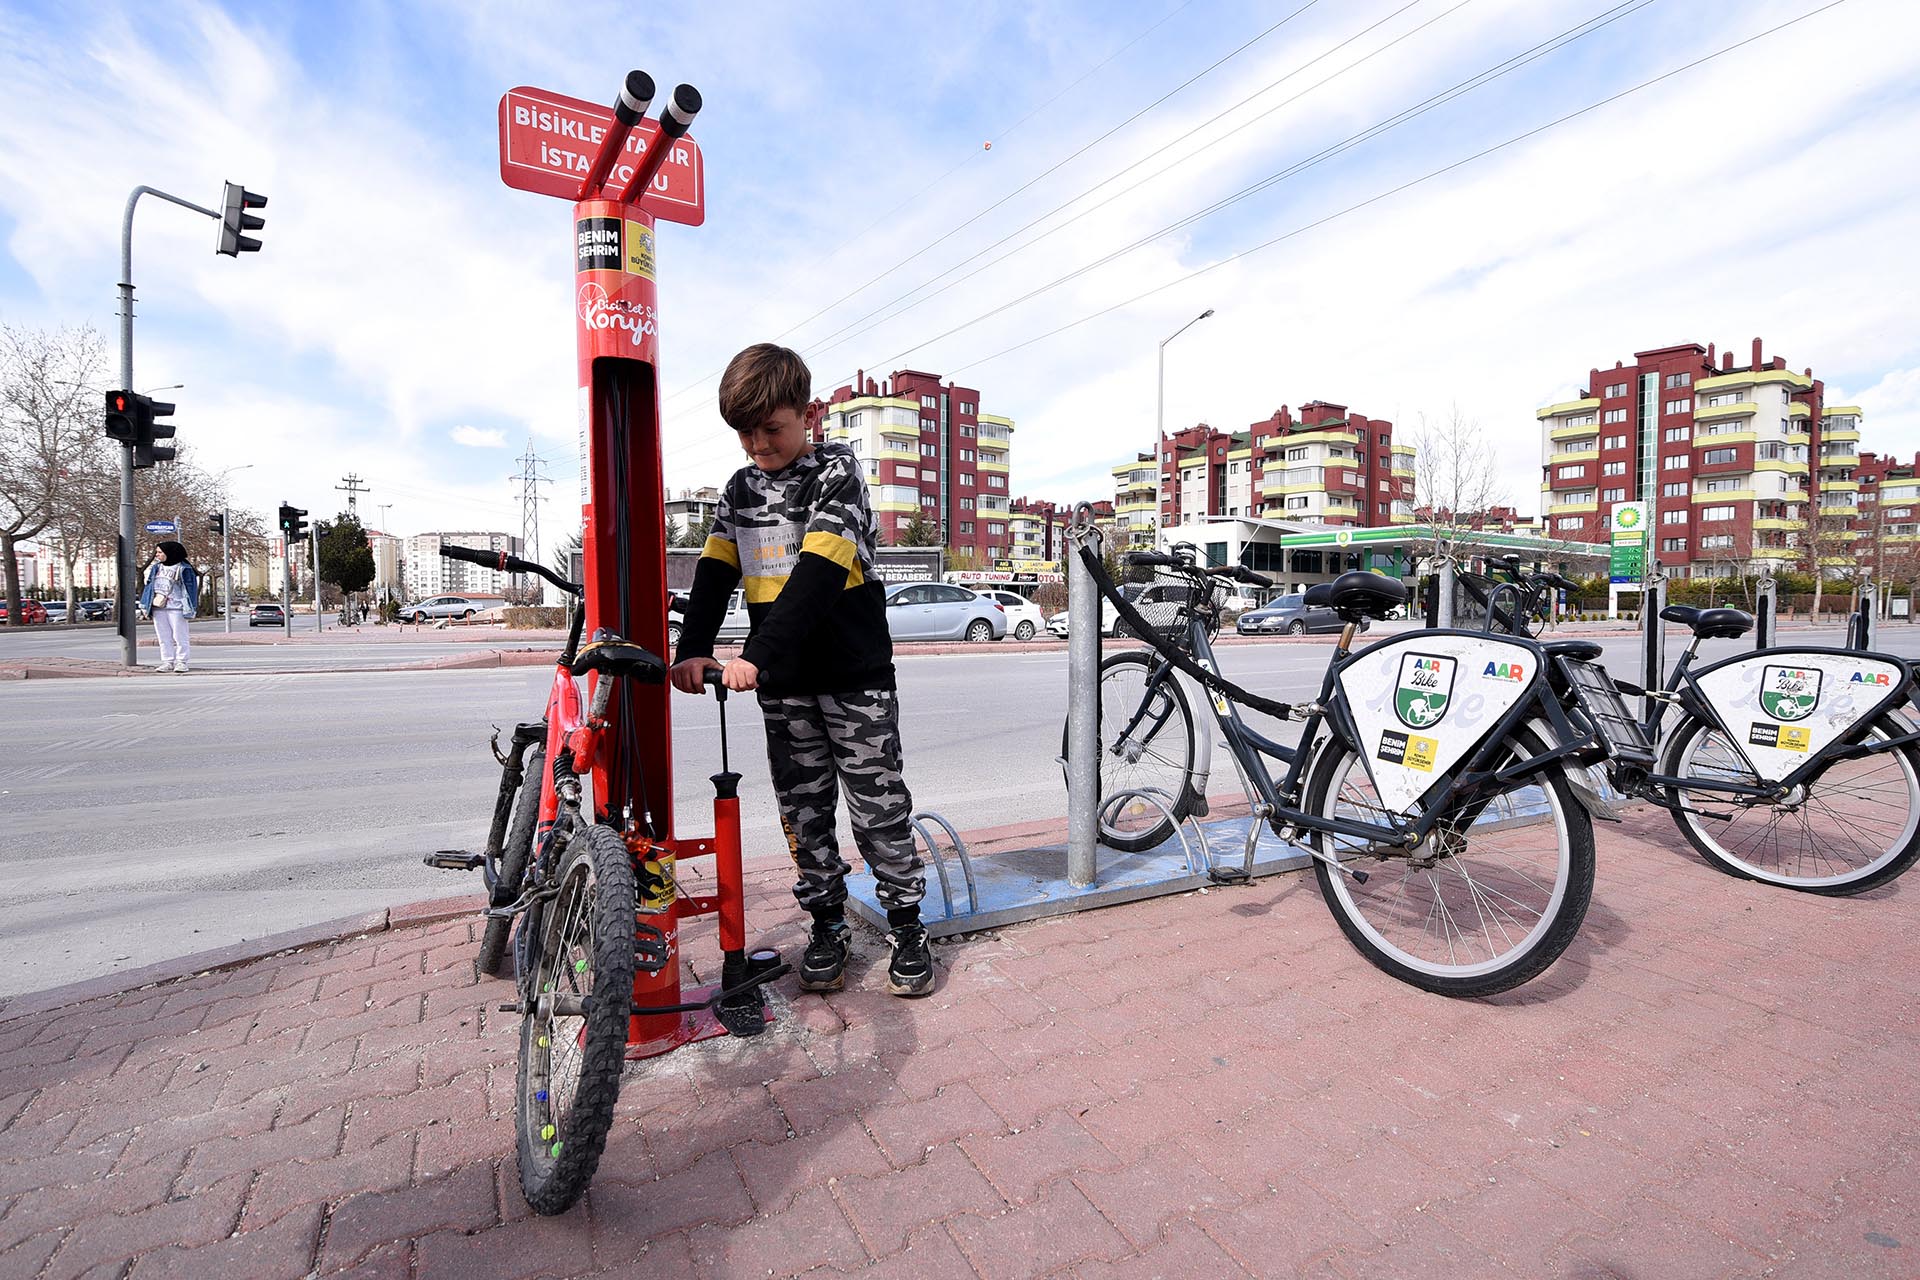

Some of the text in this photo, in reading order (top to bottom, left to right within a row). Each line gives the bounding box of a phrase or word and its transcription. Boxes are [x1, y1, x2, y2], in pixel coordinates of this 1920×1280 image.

[515, 105, 607, 145] BİSİKLE
[578, 229, 618, 246] BENİM
[578, 244, 619, 260] ŞEHRİM
[597, 298, 645, 316] Bisilet
[585, 302, 657, 346] Konya
[886, 573, 932, 581] BERABERİZ
[960, 572, 982, 580] AUTO
[984, 573, 1011, 581] TUNING
[1038, 574, 1056, 582] OTO
[1414, 659, 1440, 672] AAR
[1483, 661, 1523, 682] AAR
[1410, 670, 1439, 688] Bike
[1778, 669, 1806, 680] AAR
[1850, 672, 1889, 686] AAR
[1382, 736, 1407, 749] BENİM
